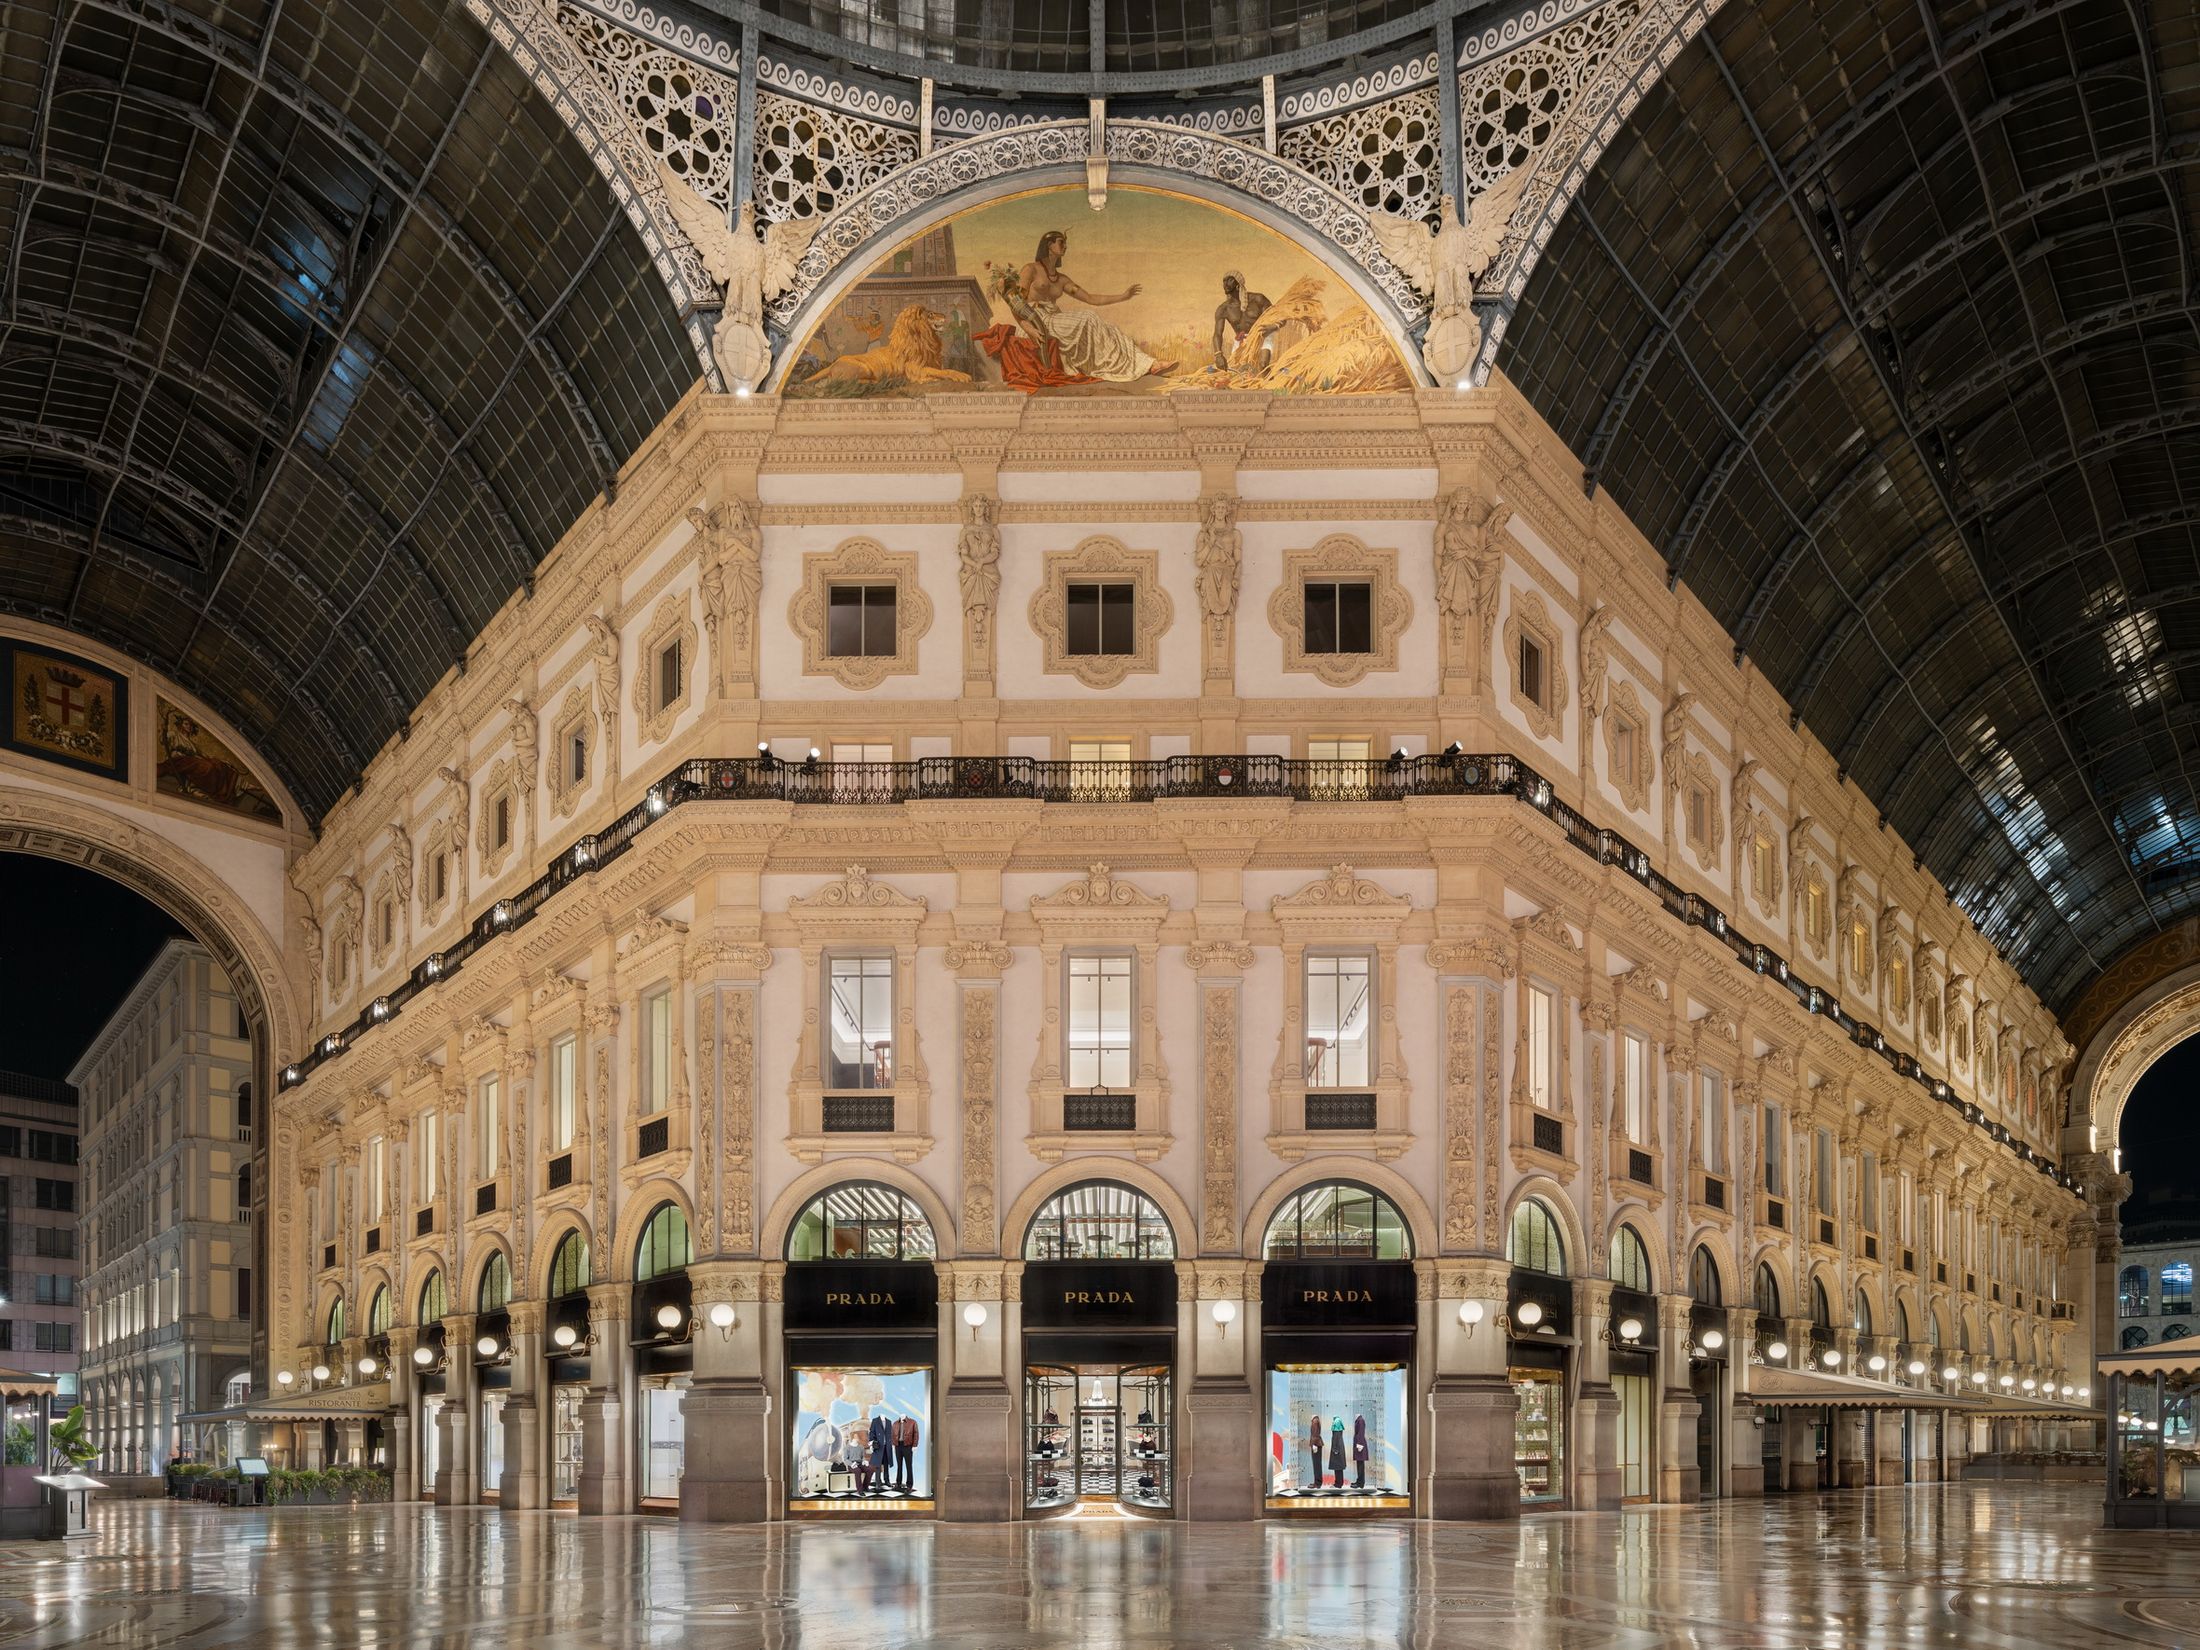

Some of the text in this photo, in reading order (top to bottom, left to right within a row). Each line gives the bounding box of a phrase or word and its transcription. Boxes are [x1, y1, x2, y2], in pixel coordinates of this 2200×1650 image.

[826, 1293, 896, 1305] PRADA
[1064, 1291, 1135, 1303] PRADA
[1303, 1290, 1373, 1302] PRADA
[308, 1399, 362, 1408] RISTORANTE
